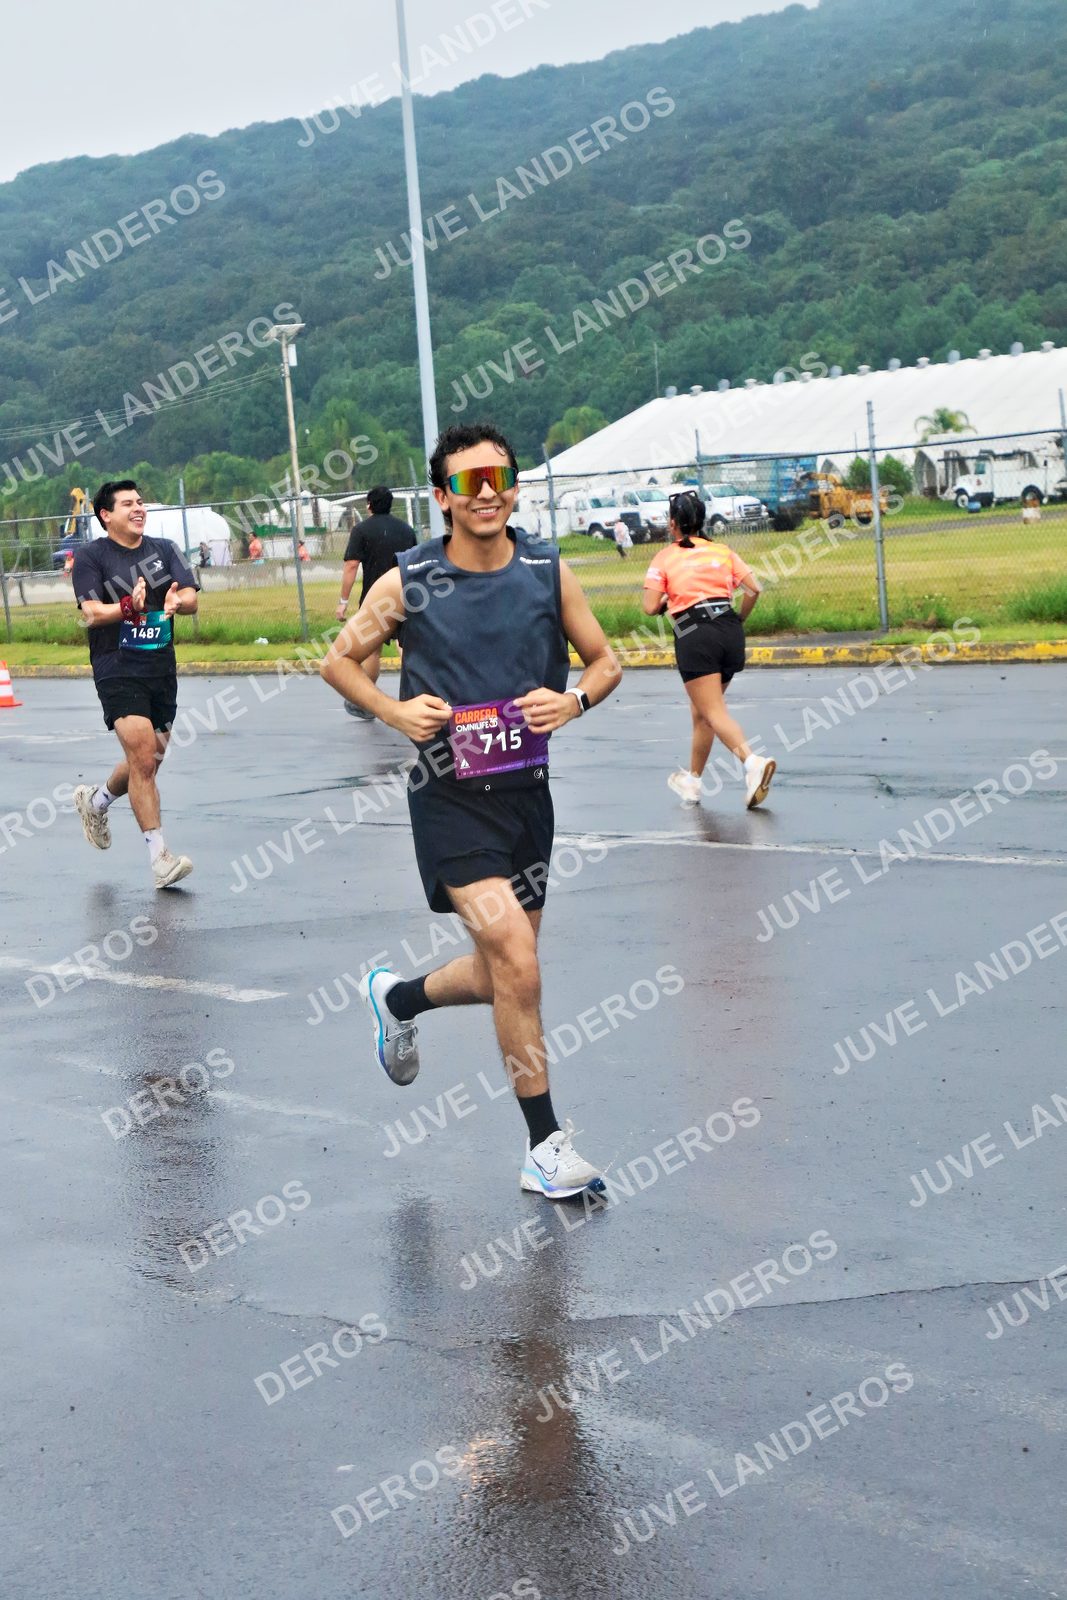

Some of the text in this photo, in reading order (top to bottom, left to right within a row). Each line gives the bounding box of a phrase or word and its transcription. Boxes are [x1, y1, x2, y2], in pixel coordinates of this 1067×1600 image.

[131, 627, 161, 639] 1487
[455, 707, 498, 724] CARRERA
[456, 720, 490, 732] OMNILIFE
[480, 729, 522, 754] 715
